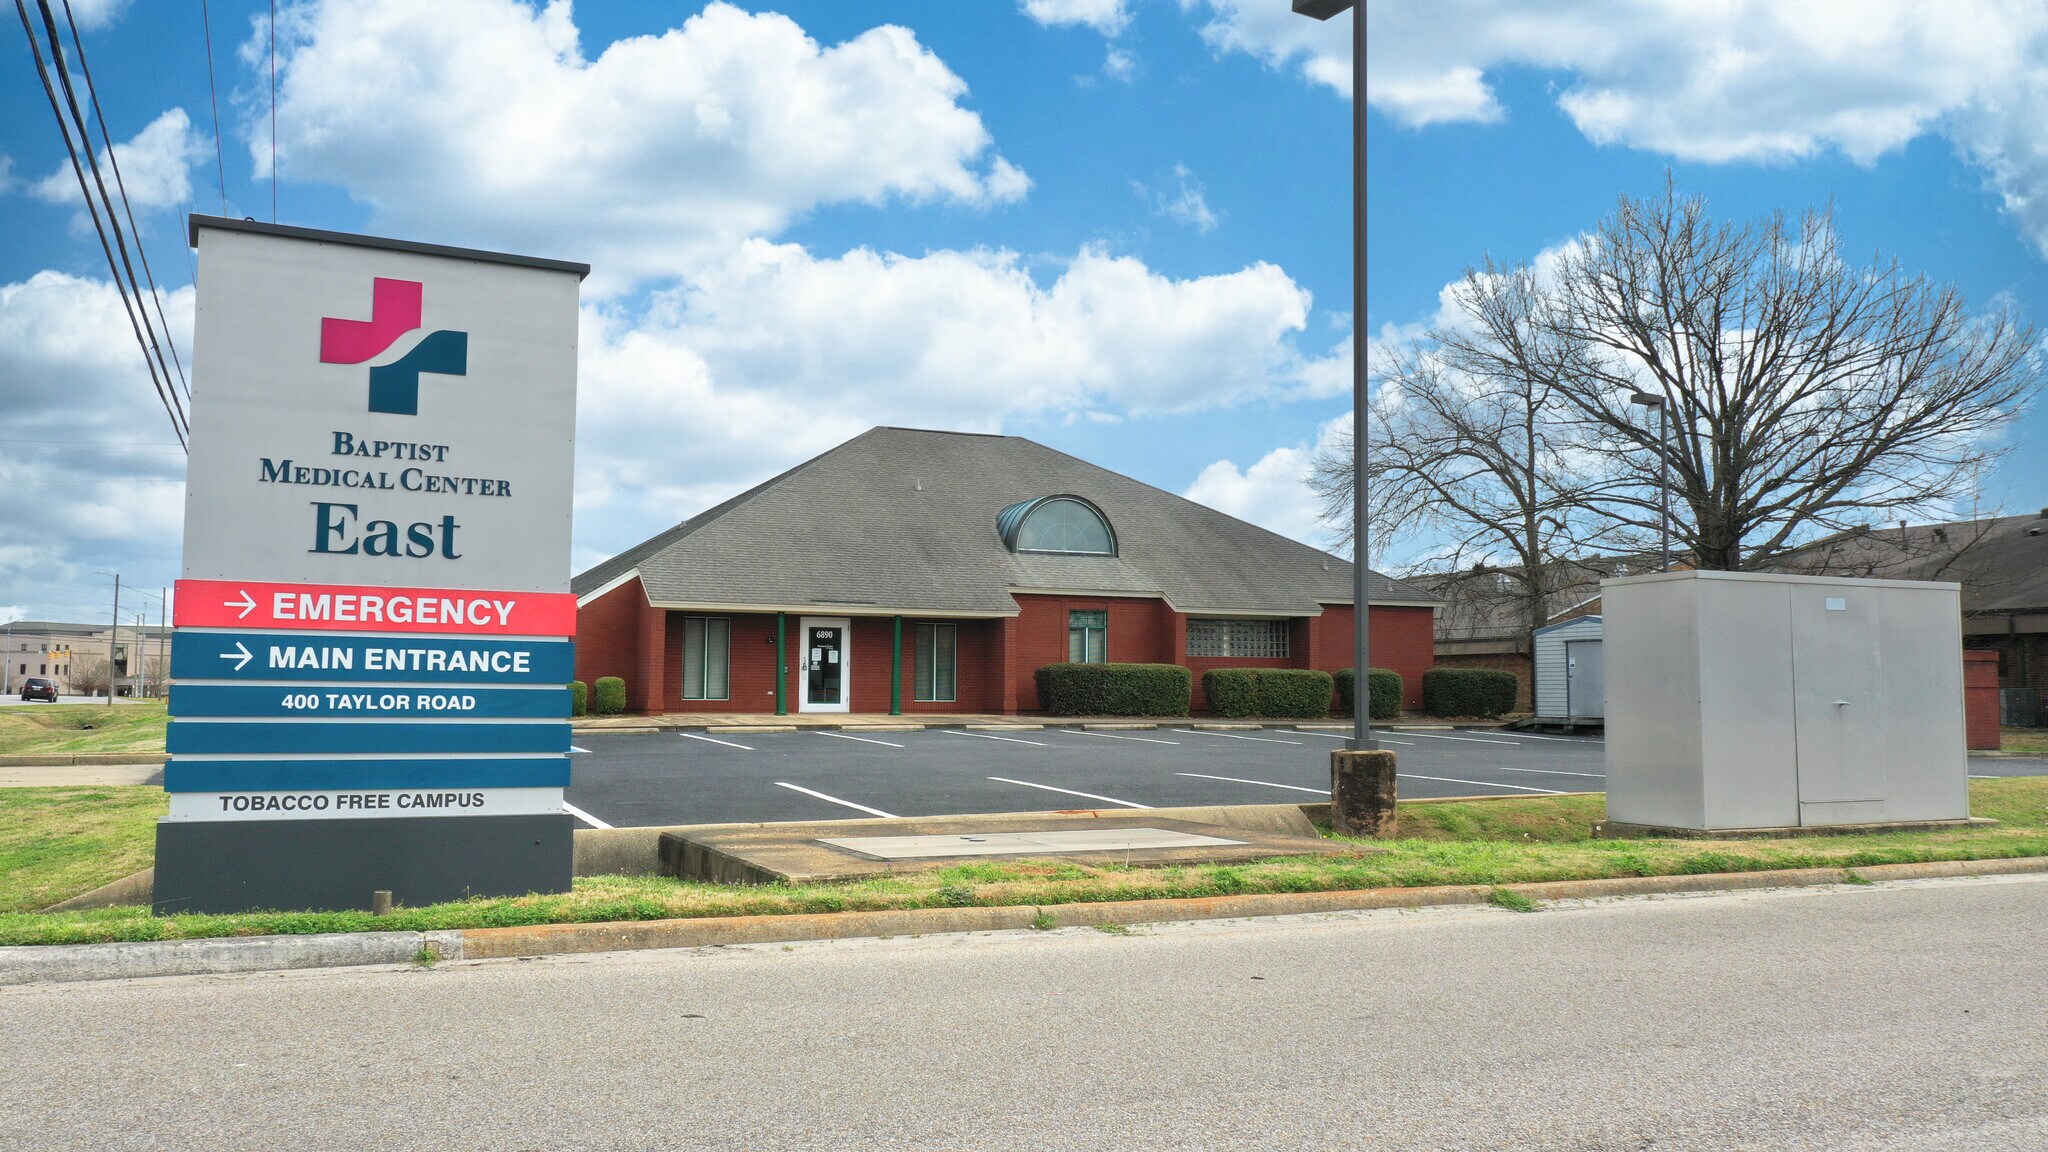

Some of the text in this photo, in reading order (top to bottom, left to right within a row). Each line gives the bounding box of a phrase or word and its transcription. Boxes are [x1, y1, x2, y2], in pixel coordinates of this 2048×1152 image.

[331, 431, 449, 462] BAPTIST
[259, 458, 512, 497] MEDICAL CENTER
[308, 502, 462, 560] East
[272, 592, 516, 626] EMERGENCY
[816, 630, 833, 639] 6890
[269, 646, 530, 673] MAIN ENTRANCE
[281, 694, 476, 710] 400 TAYLOR ROAD
[219, 792, 484, 811] TOBACCO FREE CAMPUS
